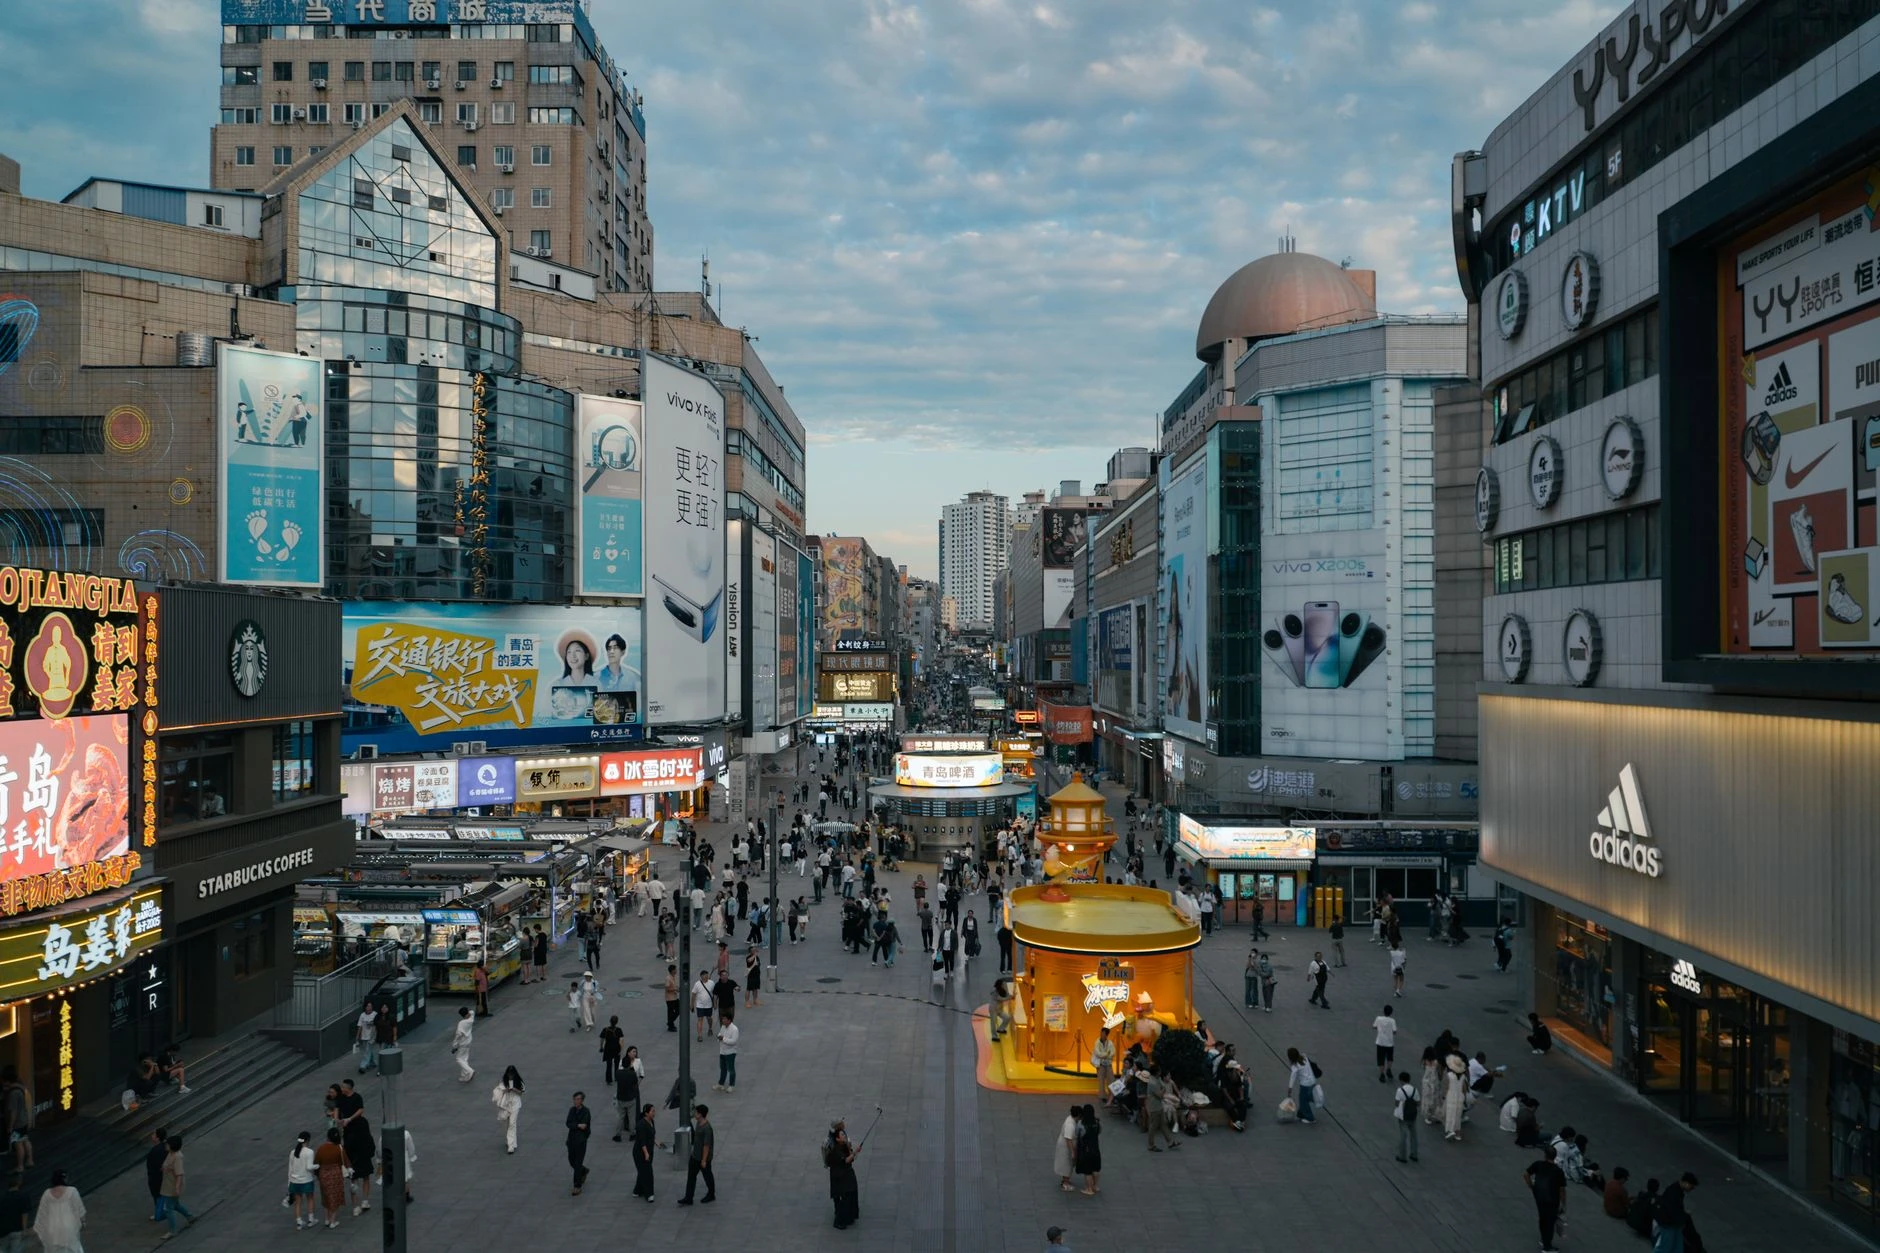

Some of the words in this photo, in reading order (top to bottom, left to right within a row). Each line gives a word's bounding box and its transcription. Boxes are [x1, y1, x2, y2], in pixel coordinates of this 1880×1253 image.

[1573, 14, 1640, 131] YY
[1607, 150, 1622, 177] 5F
[1538, 169, 1585, 238] KTV
[1824, 213, 1863, 245] 潮流地带
[1742, 256, 1758, 272] MAKE
[1759, 243, 1783, 264] SPORTS
[1783, 233, 1801, 252] YOUR
[1800, 227, 1815, 244] LIFE
[1854, 256, 1880, 296] 恒
[1753, 275, 1800, 333] YY
[667, 392, 694, 412] vivo
[695, 401, 703, 416] X
[1765, 386, 1798, 407] adidas
[675, 445, 718, 492] 更轻了
[251, 485, 297, 498] 绿色出行
[675, 488, 718, 531] 更强了
[1272, 560, 1312, 573] vivo
[1316, 559, 1366, 572] X200s
[91, 620, 137, 667] 请到
[145, 596, 158, 707] 青岛伴手礼
[353, 627, 497, 687] 交通银行
[510, 638, 534, 652] 青岛
[497, 653, 534, 668] 的夏天
[91, 665, 139, 712] 姜家
[412, 673, 526, 731] 文旅大戏
[601, 728, 631, 736] 交通银行
[677, 735, 700, 743] vivo
[624, 758, 694, 780] 冰雪时光
[708, 743, 724, 768] vivo
[378, 777, 412, 794] 烧烤
[922, 766, 976, 780] 青岛啤酒
[1268, 770, 1315, 787] 迪信通
[1590, 828, 1664, 879] adidas
[1, 849, 142, 916] 非物质文化遗产
[198, 857, 272, 899] STARBUCKS
[273, 847, 313, 877] COFFEE
[141, 899, 154, 911] DAO
[38, 906, 133, 981] 岛姜家
[1670, 970, 1701, 995] adidas
